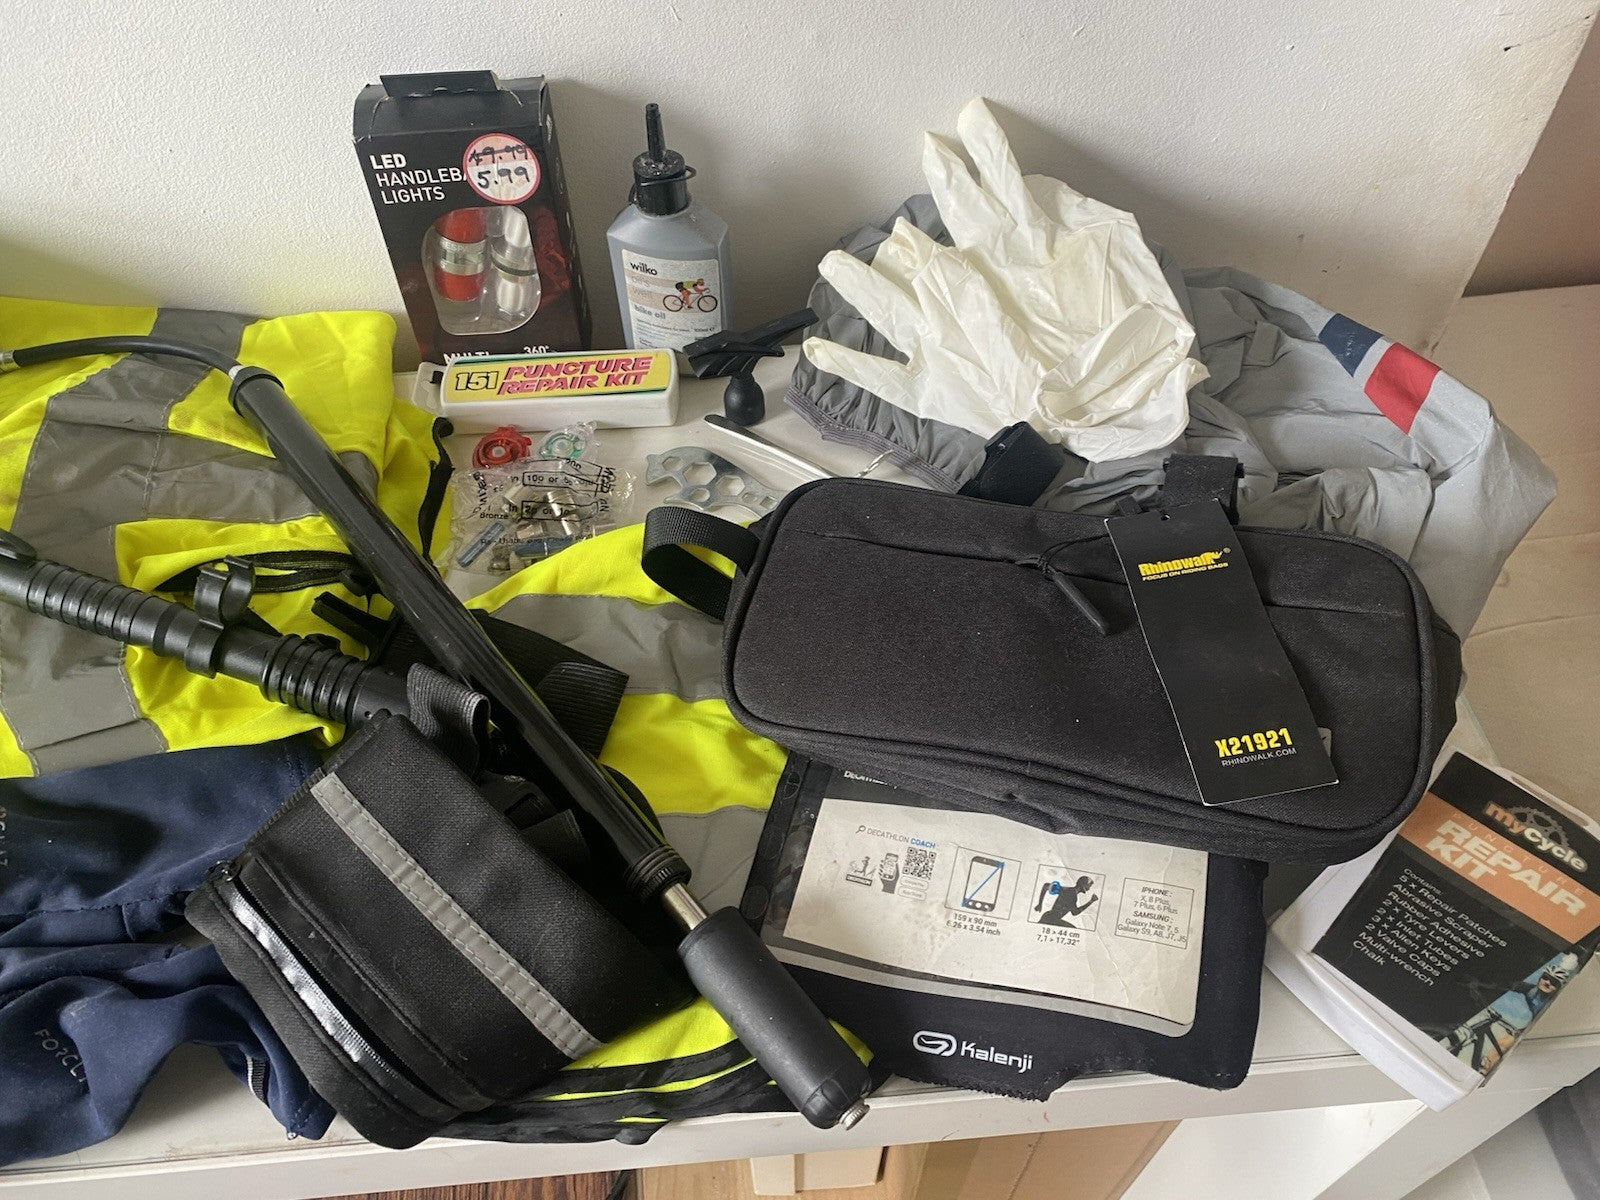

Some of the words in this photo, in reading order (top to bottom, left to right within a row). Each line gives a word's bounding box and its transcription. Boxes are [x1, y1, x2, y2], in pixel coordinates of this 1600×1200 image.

[370, 153, 407, 169] LED
[376, 167, 467, 187] HANDLEB
[477, 166, 530, 189] 5.99
[381, 186, 445, 204] LIGHTS
[630, 262, 658, 275] wilko
[634, 305, 652, 317] bike
[655, 311, 665, 319] oil
[504, 356, 653, 380] PUNCTURE
[455, 371, 499, 390] 151
[497, 375, 599, 395] REPAIR
[604, 371, 649, 387] KIT
[480, 512, 508, 520] Bronze
[1138, 551, 1220, 576] Rhinowalk
[1143, 573, 1168, 581] FOCUS
[1181, 566, 1207, 574] RIDING
[1208, 562, 1228, 570] BAGS
[1215, 727, 1293, 757] X21921
[1221, 748, 1297, 767] RHINOWALK.COM
[867, 828, 909, 843] DECATHLON
[910, 838, 936, 849] COACH
[1425, 835, 1497, 879] KIT
[1436, 820, 1586, 916] REPAIR
[954, 914, 967, 922] 159
[973, 917, 983, 925] 90
[1133, 911, 1170, 922] SAMSUNG
[1393, 883, 1443, 918] Abrasive
[1444, 916, 1493, 949] Scraper
[1399, 875, 1409, 883] 5
[1418, 888, 1458, 915] Repair
[1458, 913, 1507, 947] Patches
[969, 924, 985, 933] 3.54
[986, 926, 1001, 935] inch
[1042, 927, 1051, 935] 18
[1149, 922, 1166, 930] Note
[1376, 907, 1386, 915] 2
[1396, 920, 1421, 940] Inlet
[1424, 938, 1459, 965] Tubes
[1388, 891, 1430, 921] Rubber
[1430, 921, 1485, 958] Adhesive
[1403, 911, 1427, 932] Tyre
[1429, 930, 1470, 960] Levers
[1353, 940, 1386, 965] Chalk
[1365, 923, 1375, 931] 2
[1377, 930, 1407, 953] Valve
[1409, 953, 1441, 977] Caps
[1371, 915, 1381, 923] 3
[1390, 929, 1420, 950] Allen
[1421, 949, 1451, 972] Keys
[1359, 932, 1434, 986] Multi-wrench
[960, 1041, 1033, 1073] Kalenji
